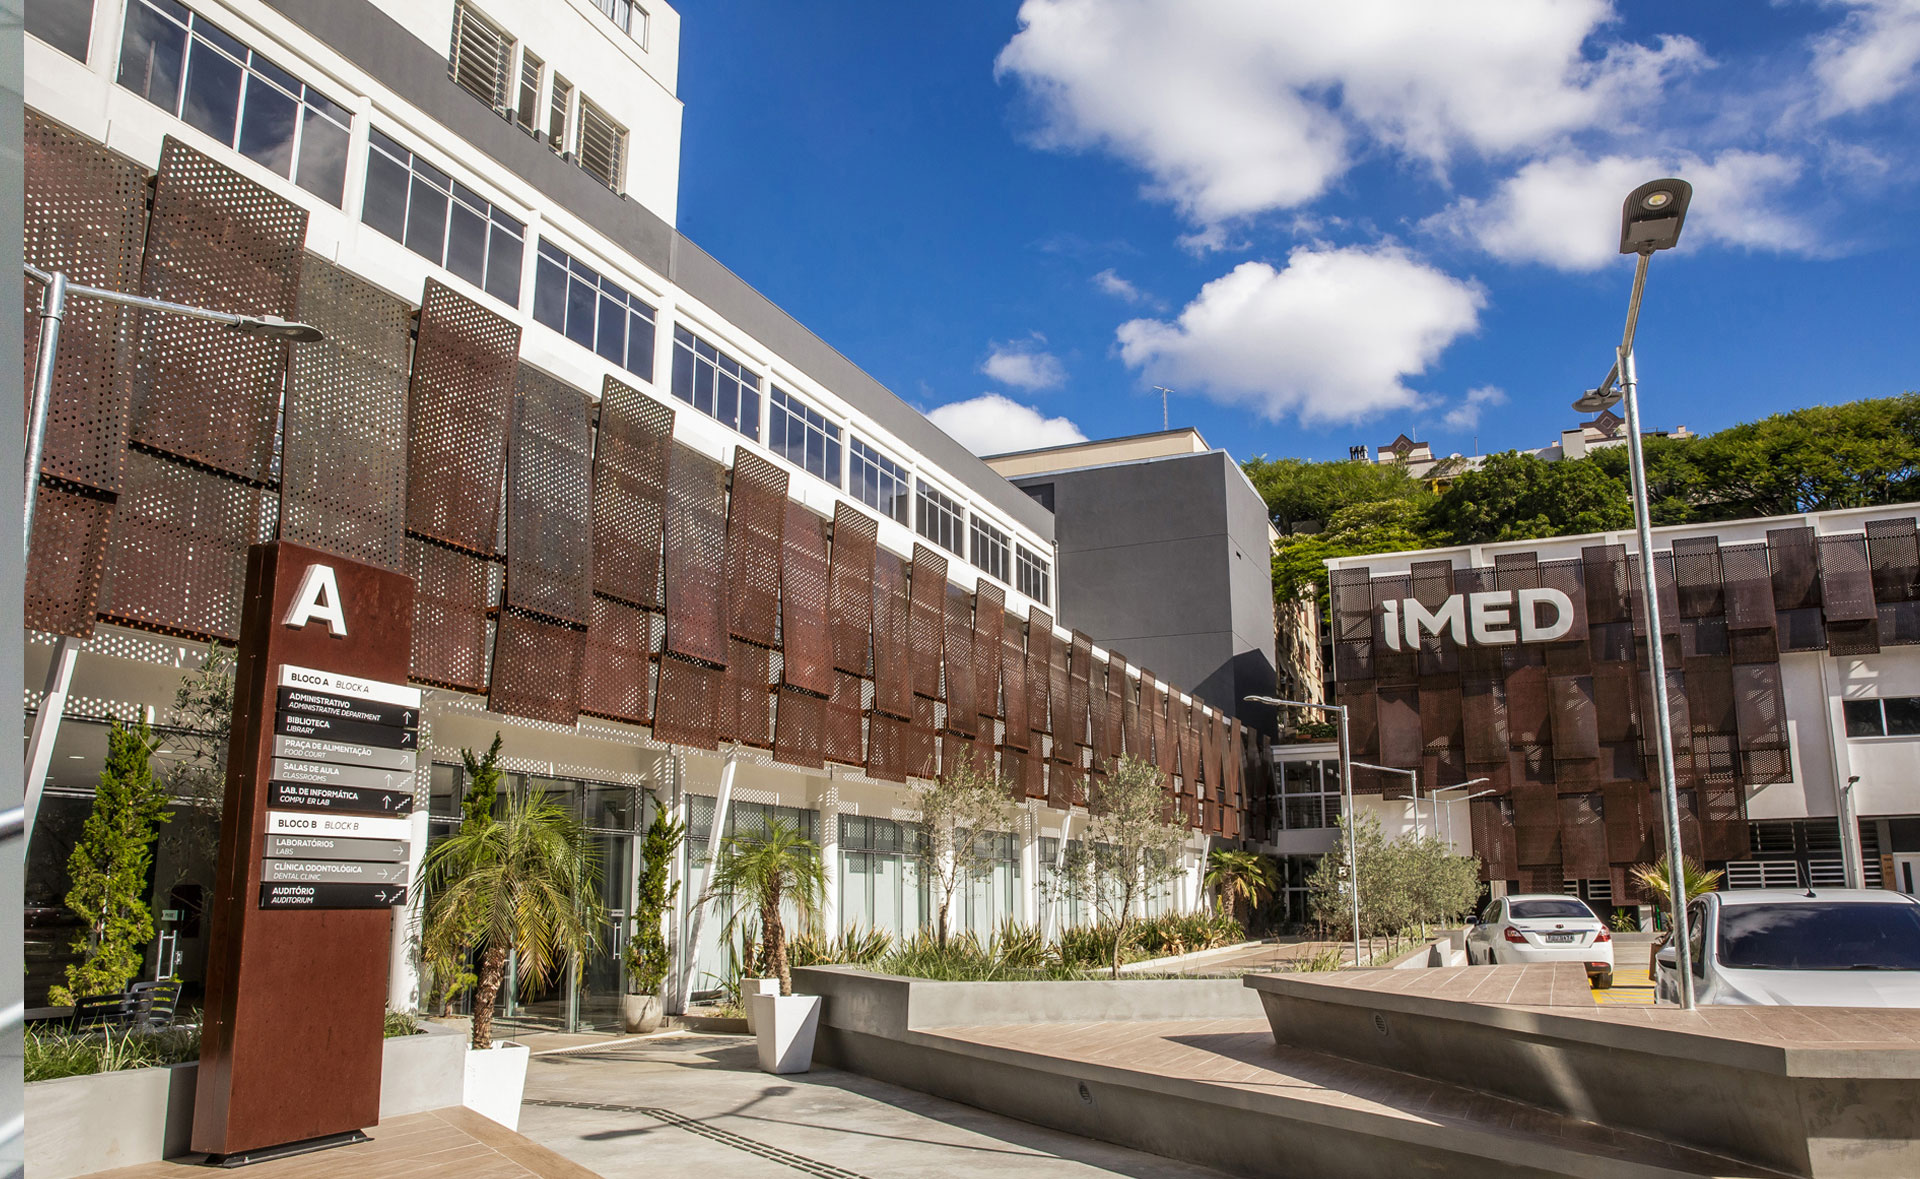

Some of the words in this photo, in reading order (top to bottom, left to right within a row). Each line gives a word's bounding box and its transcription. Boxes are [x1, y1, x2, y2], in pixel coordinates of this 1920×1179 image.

[281, 563, 348, 637] A
[291, 672, 320, 684] BLOCO
[335, 680, 361, 691] BLOCK
[289, 692, 350, 708] ADMINISTRATIVO
[288, 701, 340, 715] ADMINISTRATIVE
[341, 709, 380, 721] DEPARTMENT
[286, 715, 329, 728] BIBLIOTECA
[286, 725, 314, 733] LIBRARY
[283, 748, 302, 756] FOOD
[304, 750, 326, 758] COURT
[285, 739, 310, 749] PRAÇA
[322, 743, 371, 756] ALIMENTAÇÃO
[283, 762, 307, 771] SALAS
[320, 766, 339, 774] AULA
[282, 771, 326, 781] CLASSROOMS
[280, 785, 297, 794] LAB.
[298, 787, 308, 795] DE
[309, 788, 358, 800] INFORMÁTICA
[278, 819, 308, 827] BLOCO
[311, 820, 317, 828] B
[324, 821, 351, 829] BLOCK
[353, 822, 359, 830] B
[276, 838, 334, 847] LABORATÓRIOS
[274, 861, 303, 870] CLÍNICA
[305, 863, 362, 873] ODONTOLÓGICA
[271, 885, 314, 895] AUDITÓRIO
